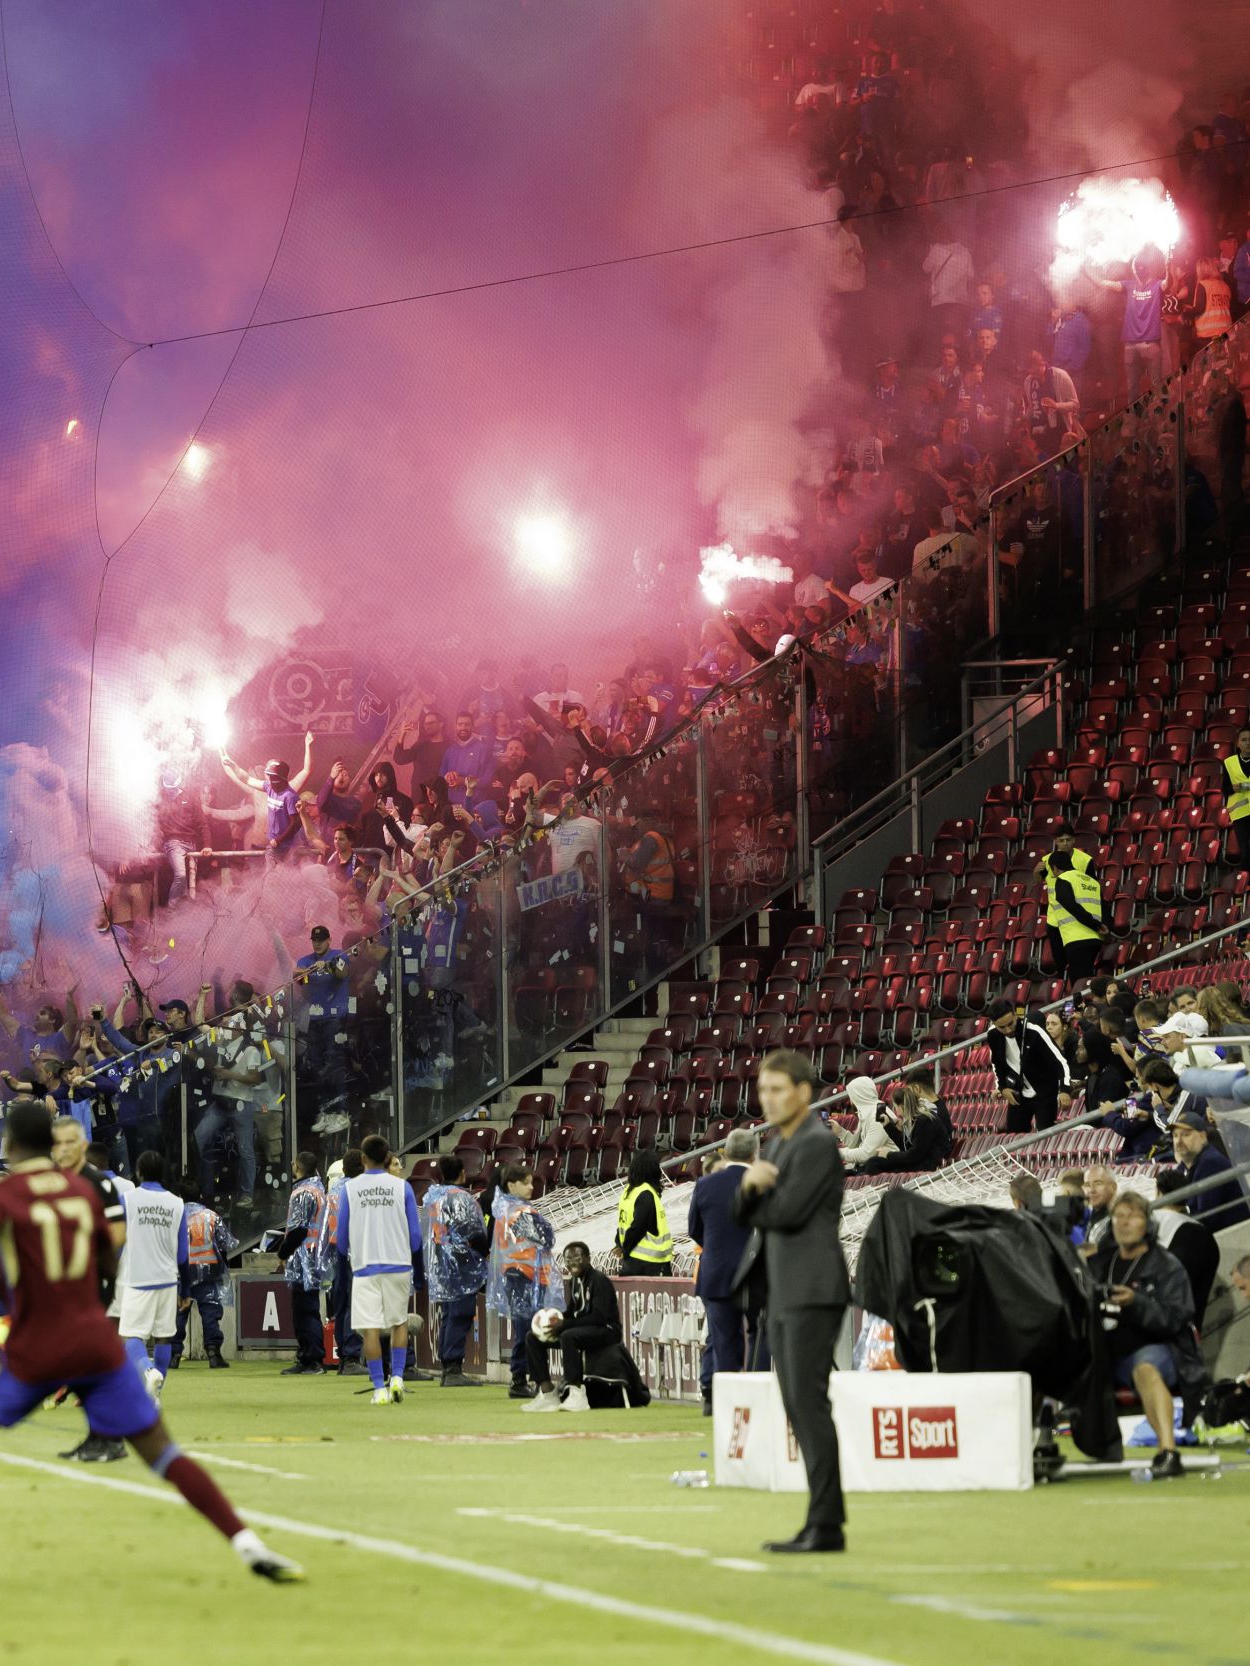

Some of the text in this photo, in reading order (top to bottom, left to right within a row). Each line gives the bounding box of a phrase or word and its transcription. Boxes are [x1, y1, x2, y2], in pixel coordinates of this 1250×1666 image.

[357, 1185, 395, 1198] voetbal
[360, 1197, 395, 1209] shop.be
[137, 1204, 175, 1218] voetbal
[138, 1216, 173, 1229] shop.be
[29, 1195, 95, 1283] 17
[262, 1291, 281, 1331] A
[878, 1409, 955, 1457] RTS Sport
